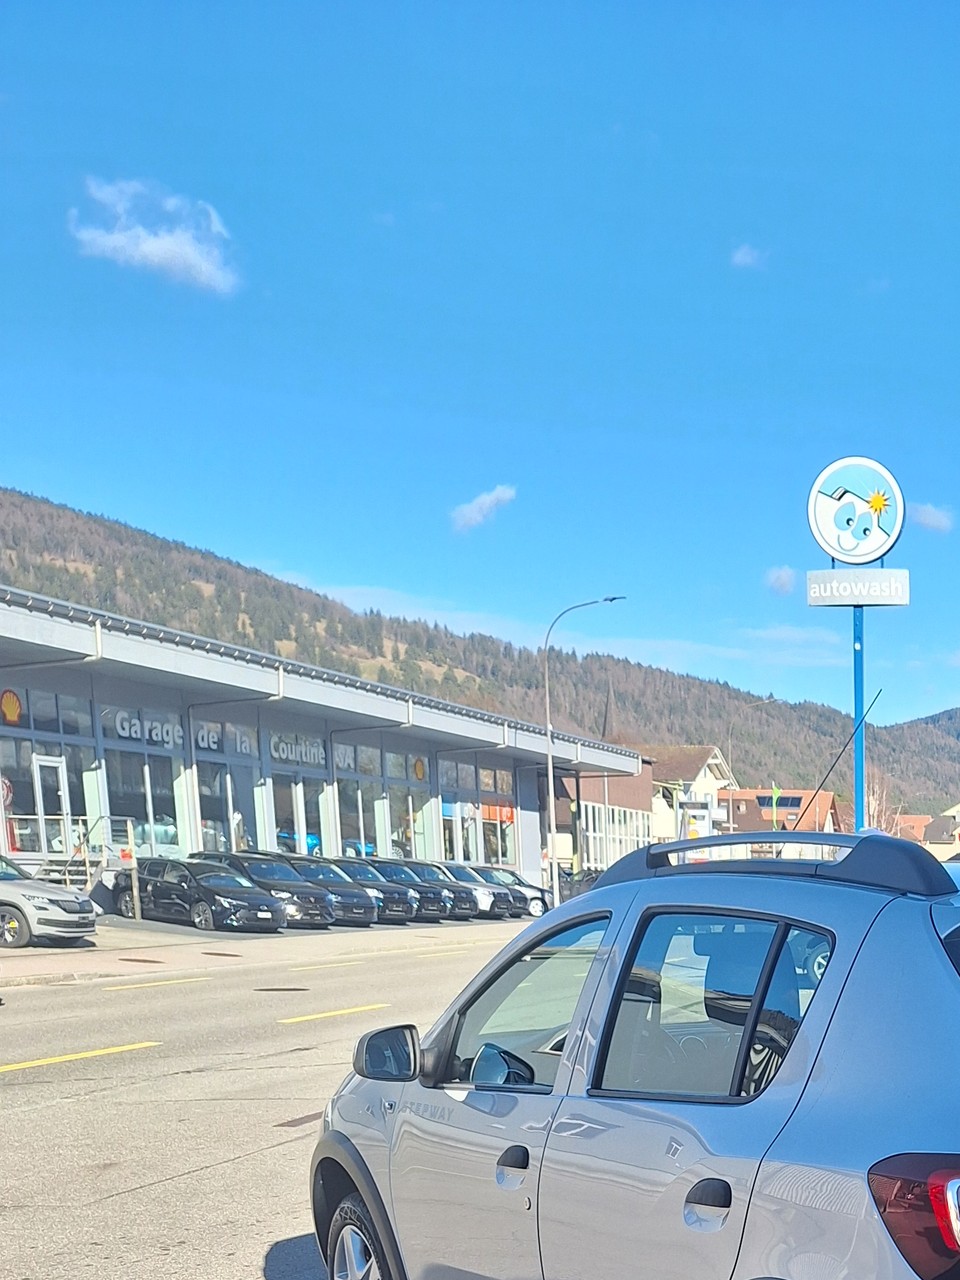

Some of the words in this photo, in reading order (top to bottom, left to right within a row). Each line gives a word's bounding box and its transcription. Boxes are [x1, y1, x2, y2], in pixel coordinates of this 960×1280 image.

[809, 577, 903, 597] autowash
[115, 710, 184, 749] Garage
[197, 724, 218, 749] de
[235, 730, 250, 754] la
[269, 735, 327, 765] Courtine
[401, 1101, 455, 1121] STEPWAY
